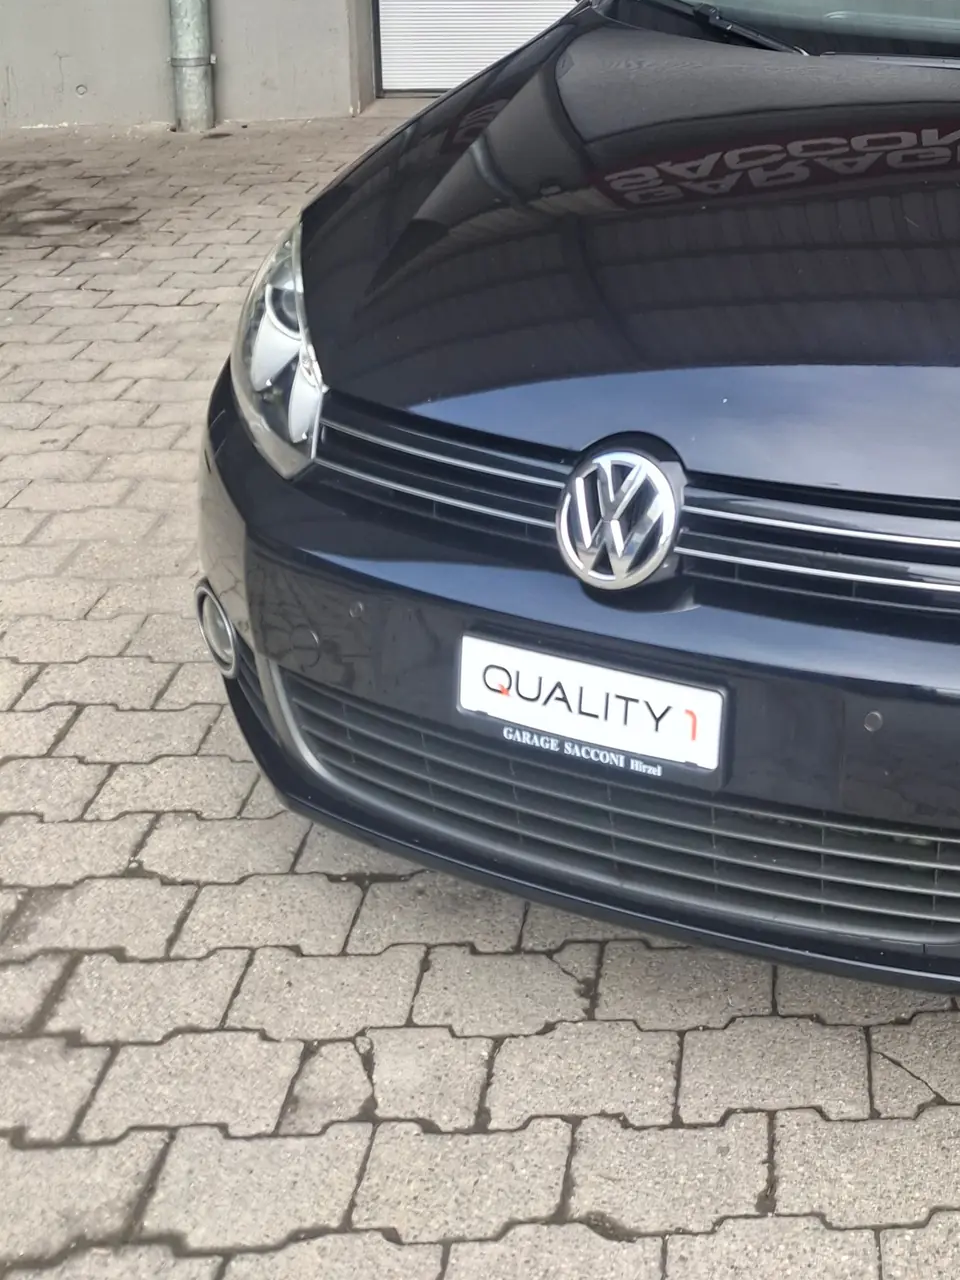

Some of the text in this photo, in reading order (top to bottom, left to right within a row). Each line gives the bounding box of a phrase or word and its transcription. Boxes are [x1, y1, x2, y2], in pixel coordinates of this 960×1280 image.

[556, 451, 677, 590] VW
[482, 664, 697, 741] QUALITY 1
[502, 726, 663, 777] GARAGE SACCONI Hirzel
